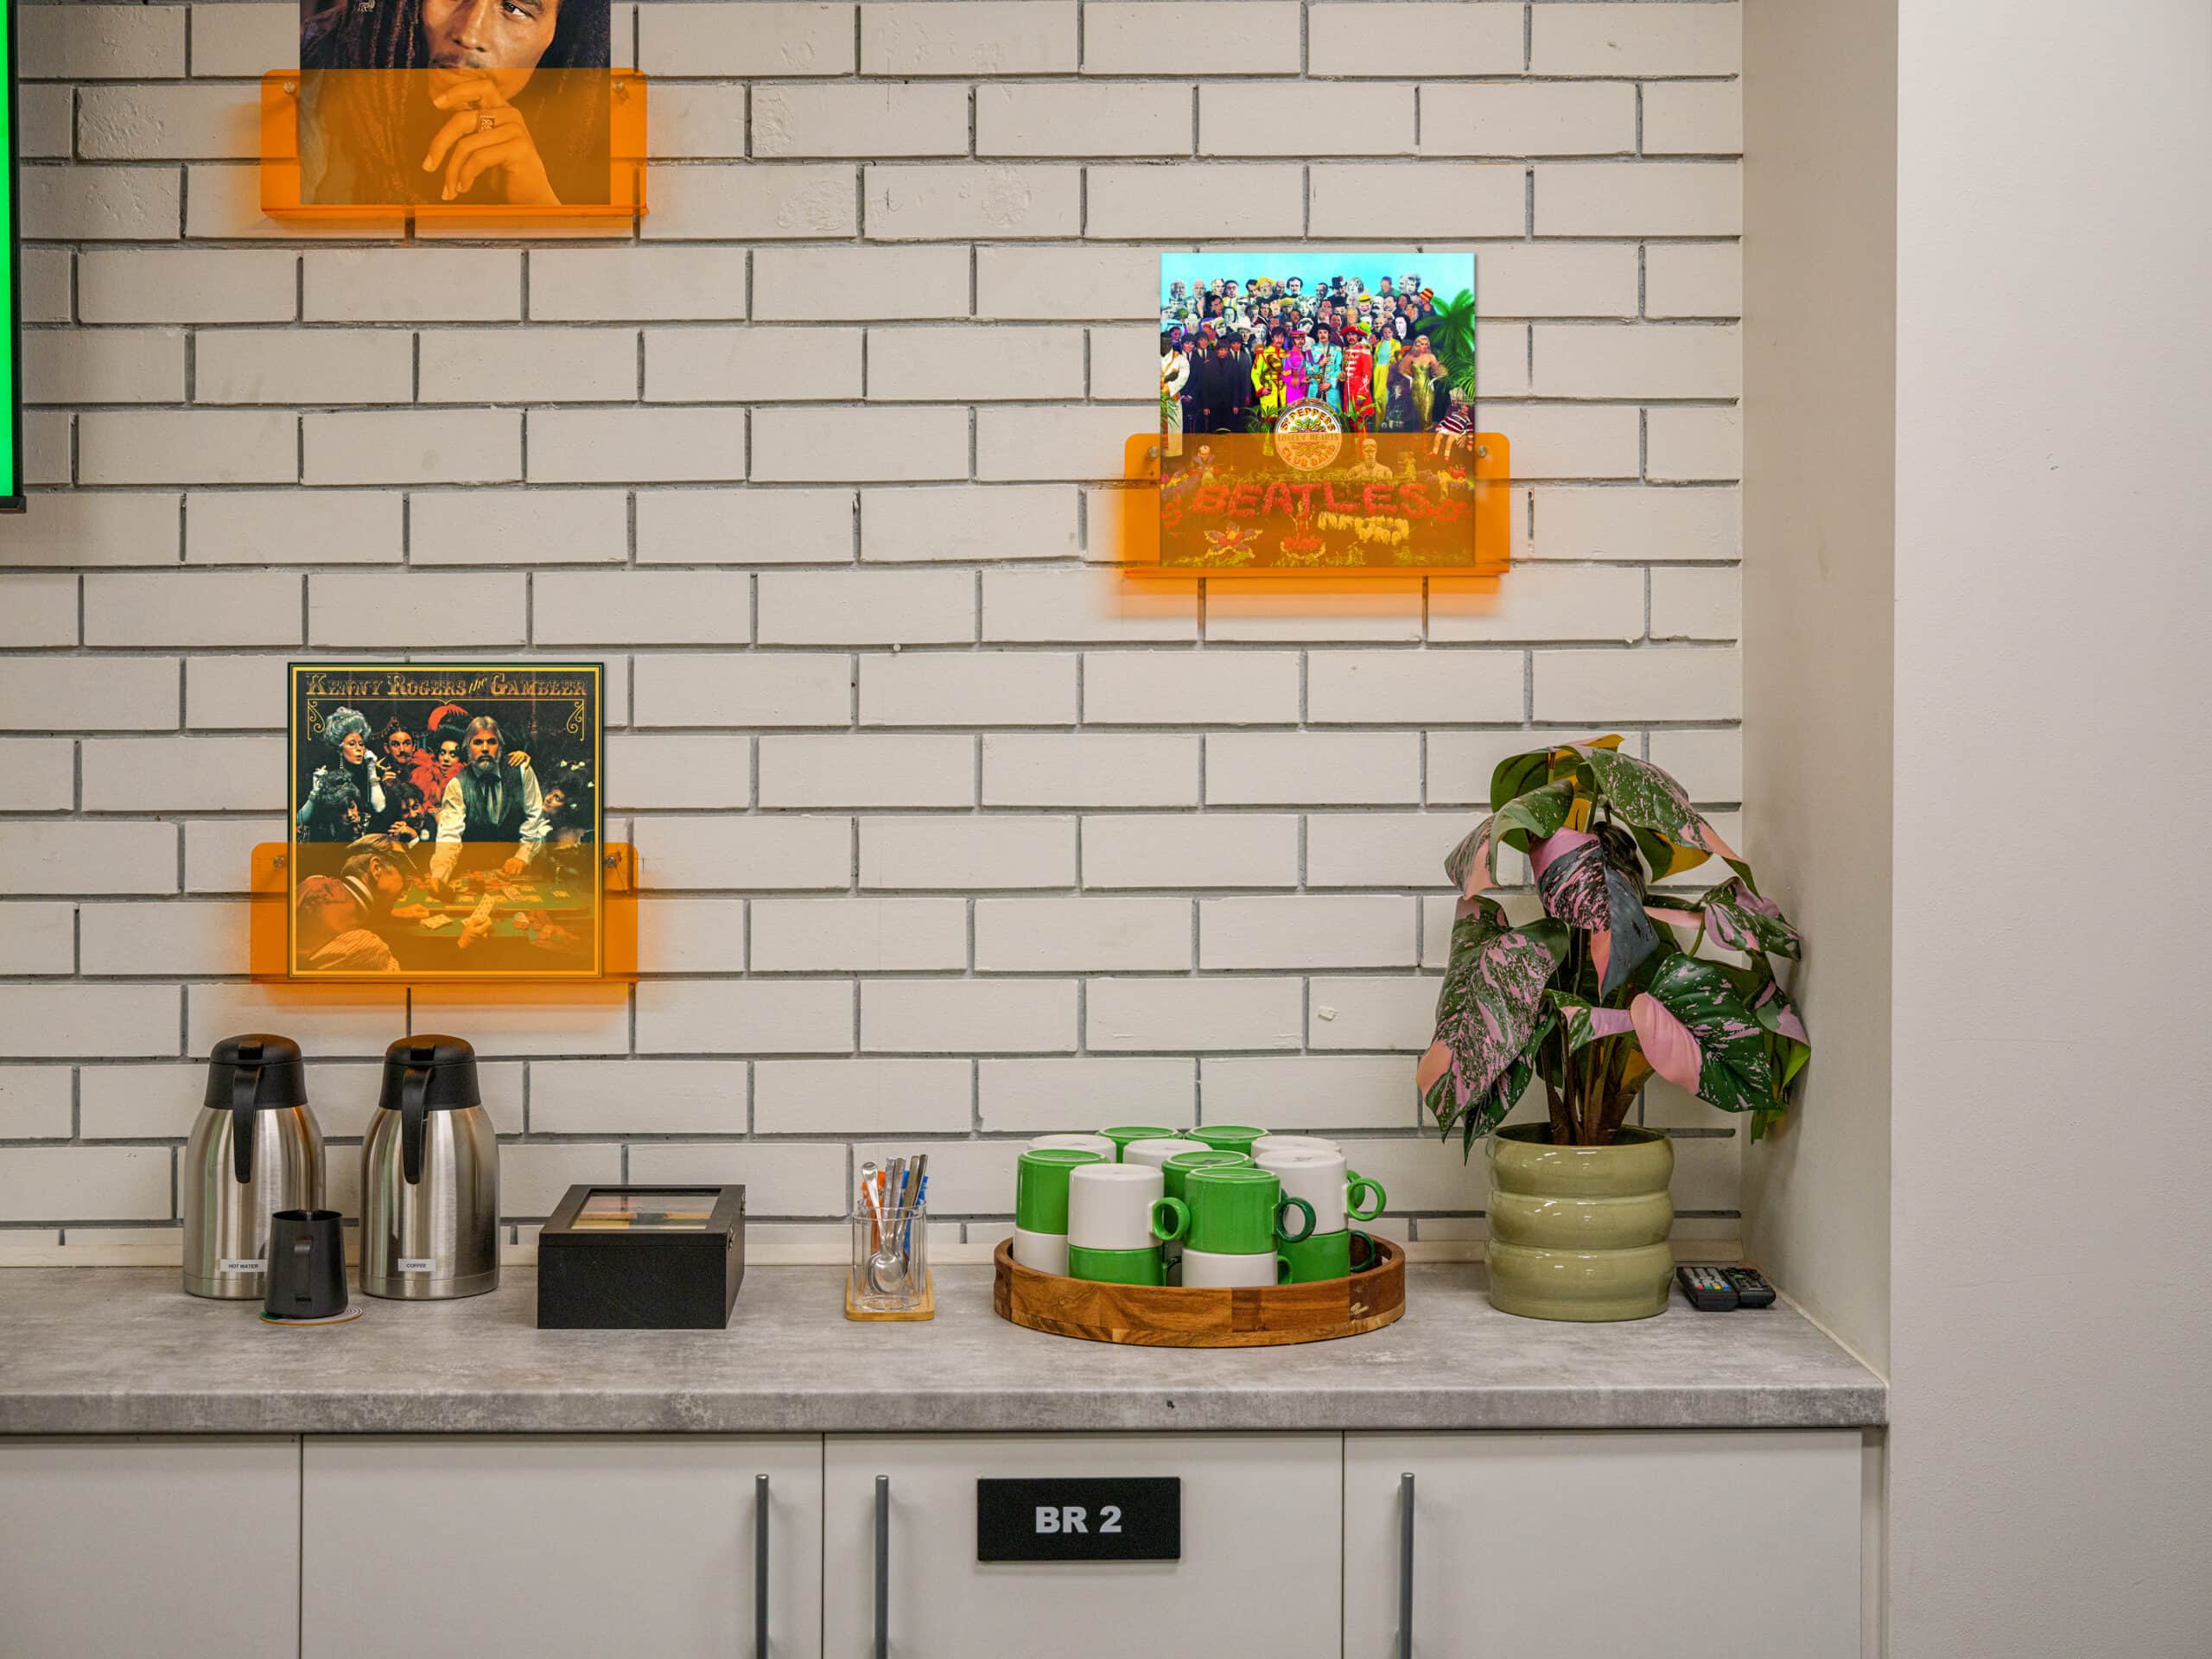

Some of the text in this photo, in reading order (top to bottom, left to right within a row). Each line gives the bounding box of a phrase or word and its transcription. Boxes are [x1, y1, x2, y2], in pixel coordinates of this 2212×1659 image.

[1192, 481, 1431, 518] BEATLES
[305, 673, 384, 696] KENNY
[387, 672, 467, 696] ROGERS
[1035, 1505, 1122, 1534] BR 2
